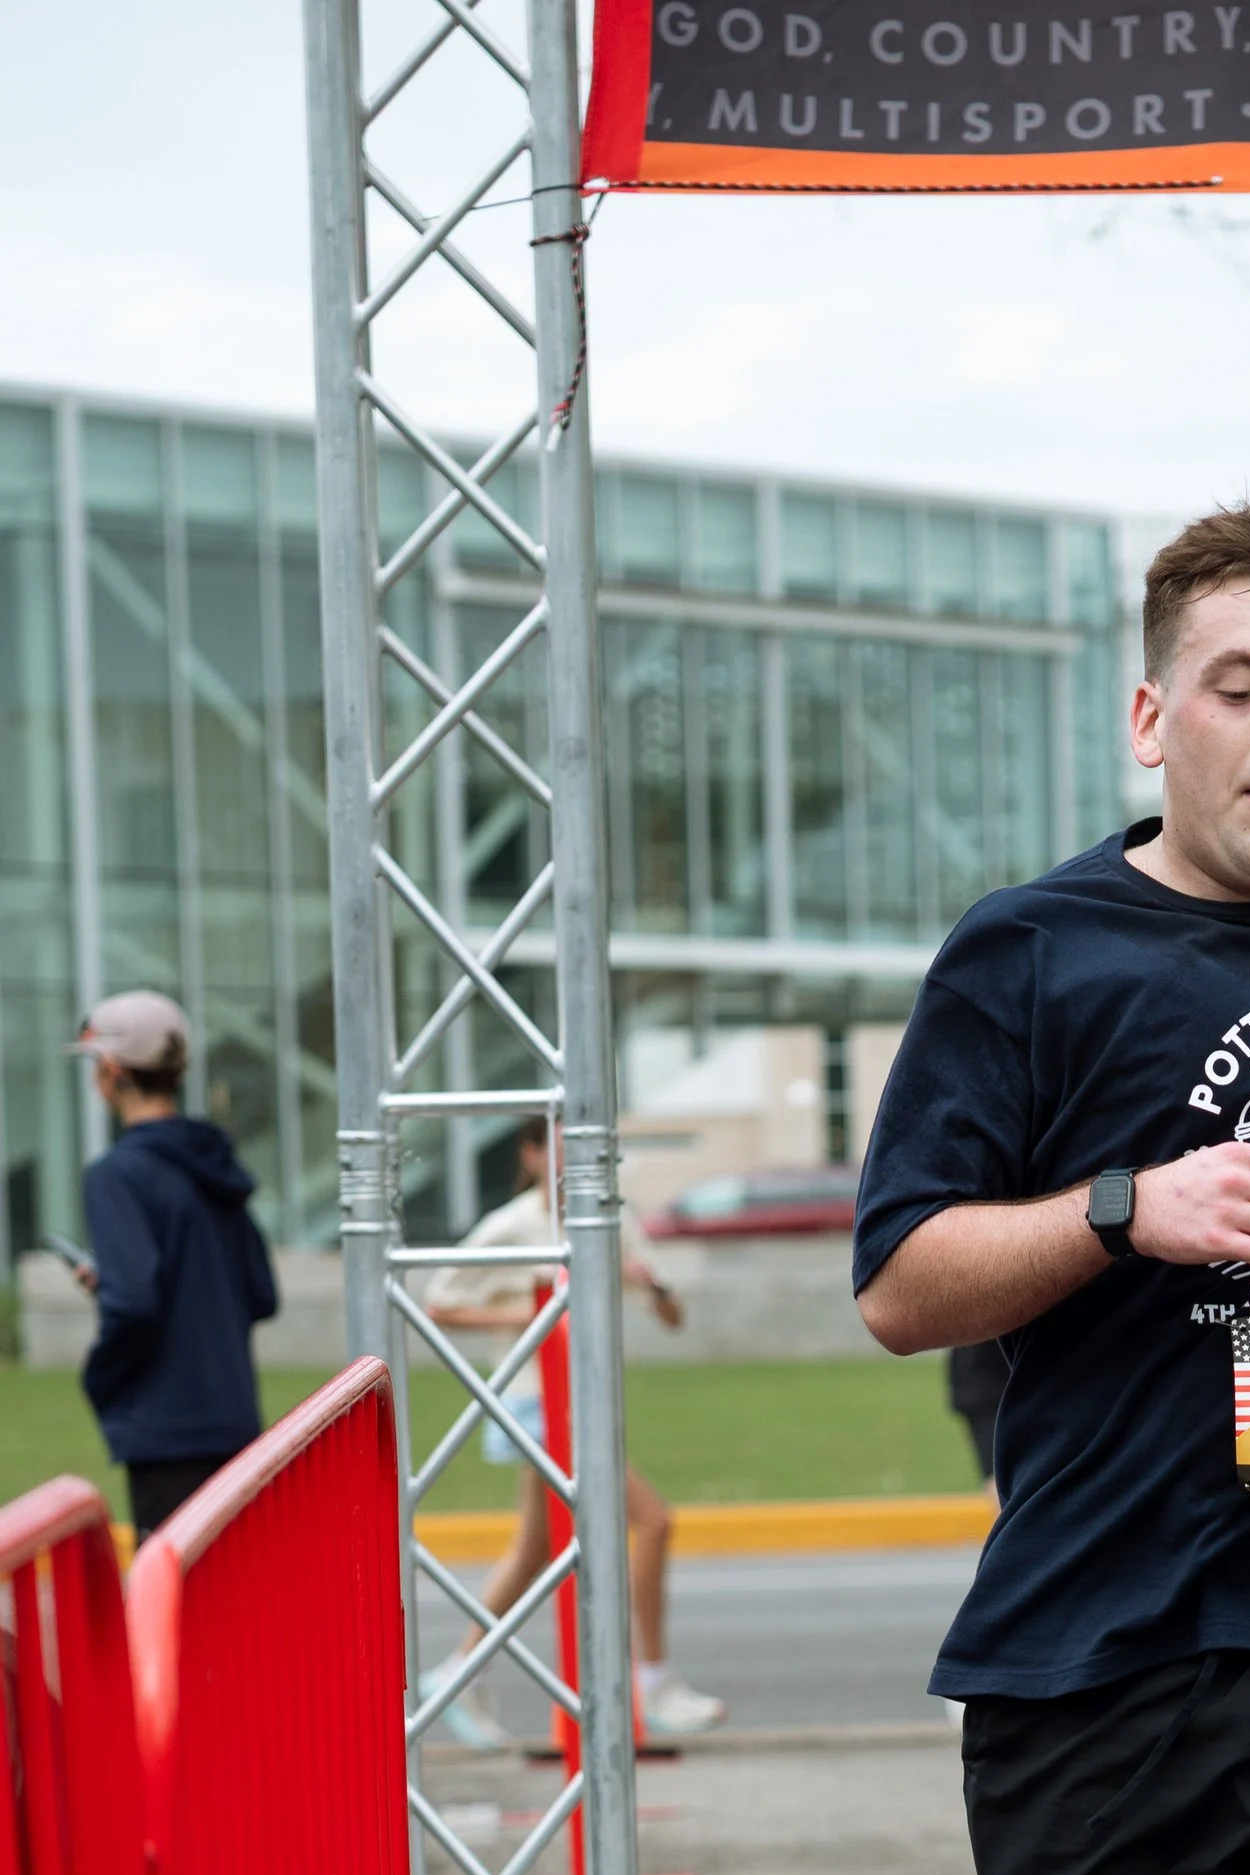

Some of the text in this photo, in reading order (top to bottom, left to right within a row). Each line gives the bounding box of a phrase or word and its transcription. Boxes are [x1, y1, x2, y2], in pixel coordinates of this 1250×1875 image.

[657, 1, 833, 63] GOD,
[707, 89, 1213, 142] MULTISPORT
[1190, 1303, 1235, 1324] 4TH
